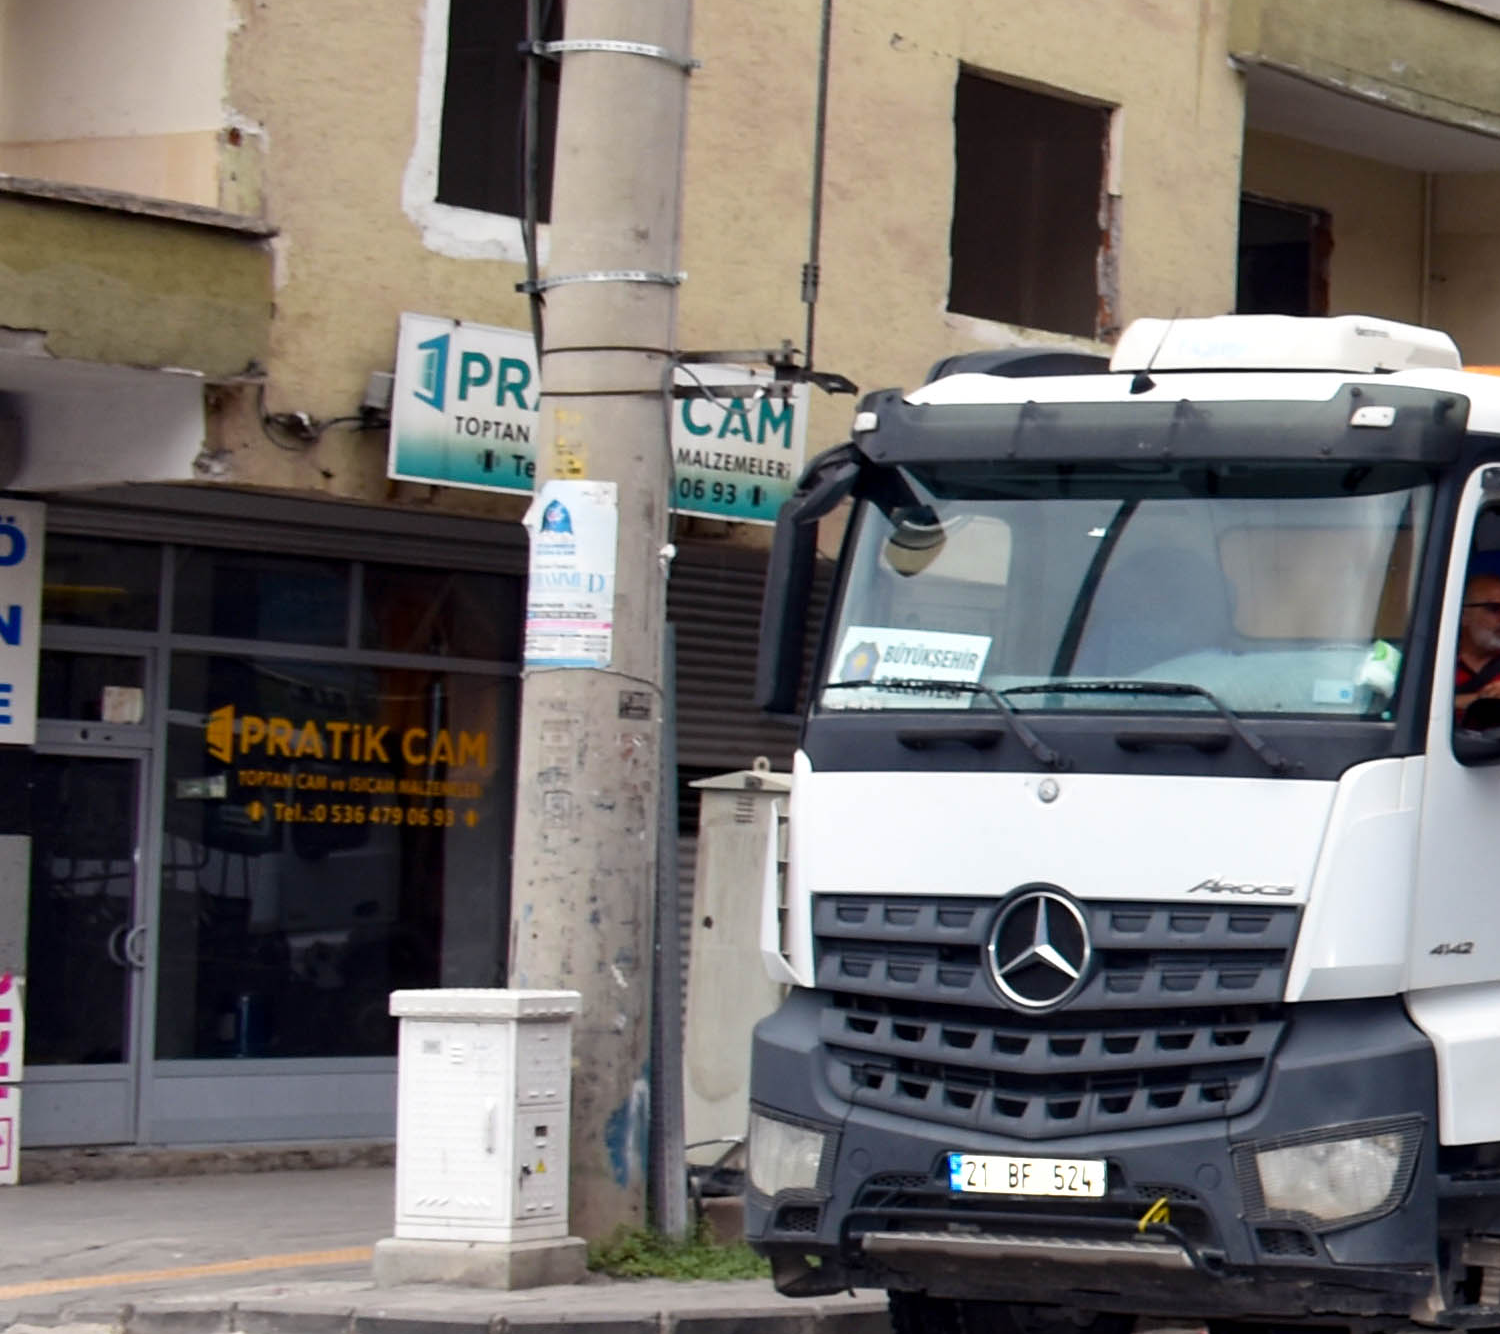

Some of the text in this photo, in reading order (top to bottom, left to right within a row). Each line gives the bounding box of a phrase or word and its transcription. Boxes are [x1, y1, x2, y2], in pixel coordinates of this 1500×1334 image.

[458, 351, 795, 449] PR CAM
[455, 415, 530, 443] TOPTAN
[680, 478, 705, 500] 06
[714, 481, 737, 505] 93
[883, 642, 979, 672] BÜYÜKŞEHİR
[401, 727, 489, 767] CAM
[239, 770, 292, 788] TOPTAN
[296, 773, 328, 791] CAM
[332, 804, 364, 824] 536
[370, 806, 400, 825] 479
[407, 807, 430, 826] 06
[434, 809, 455, 827] 93
[965, 1161, 1092, 1193] 21 BF 524
